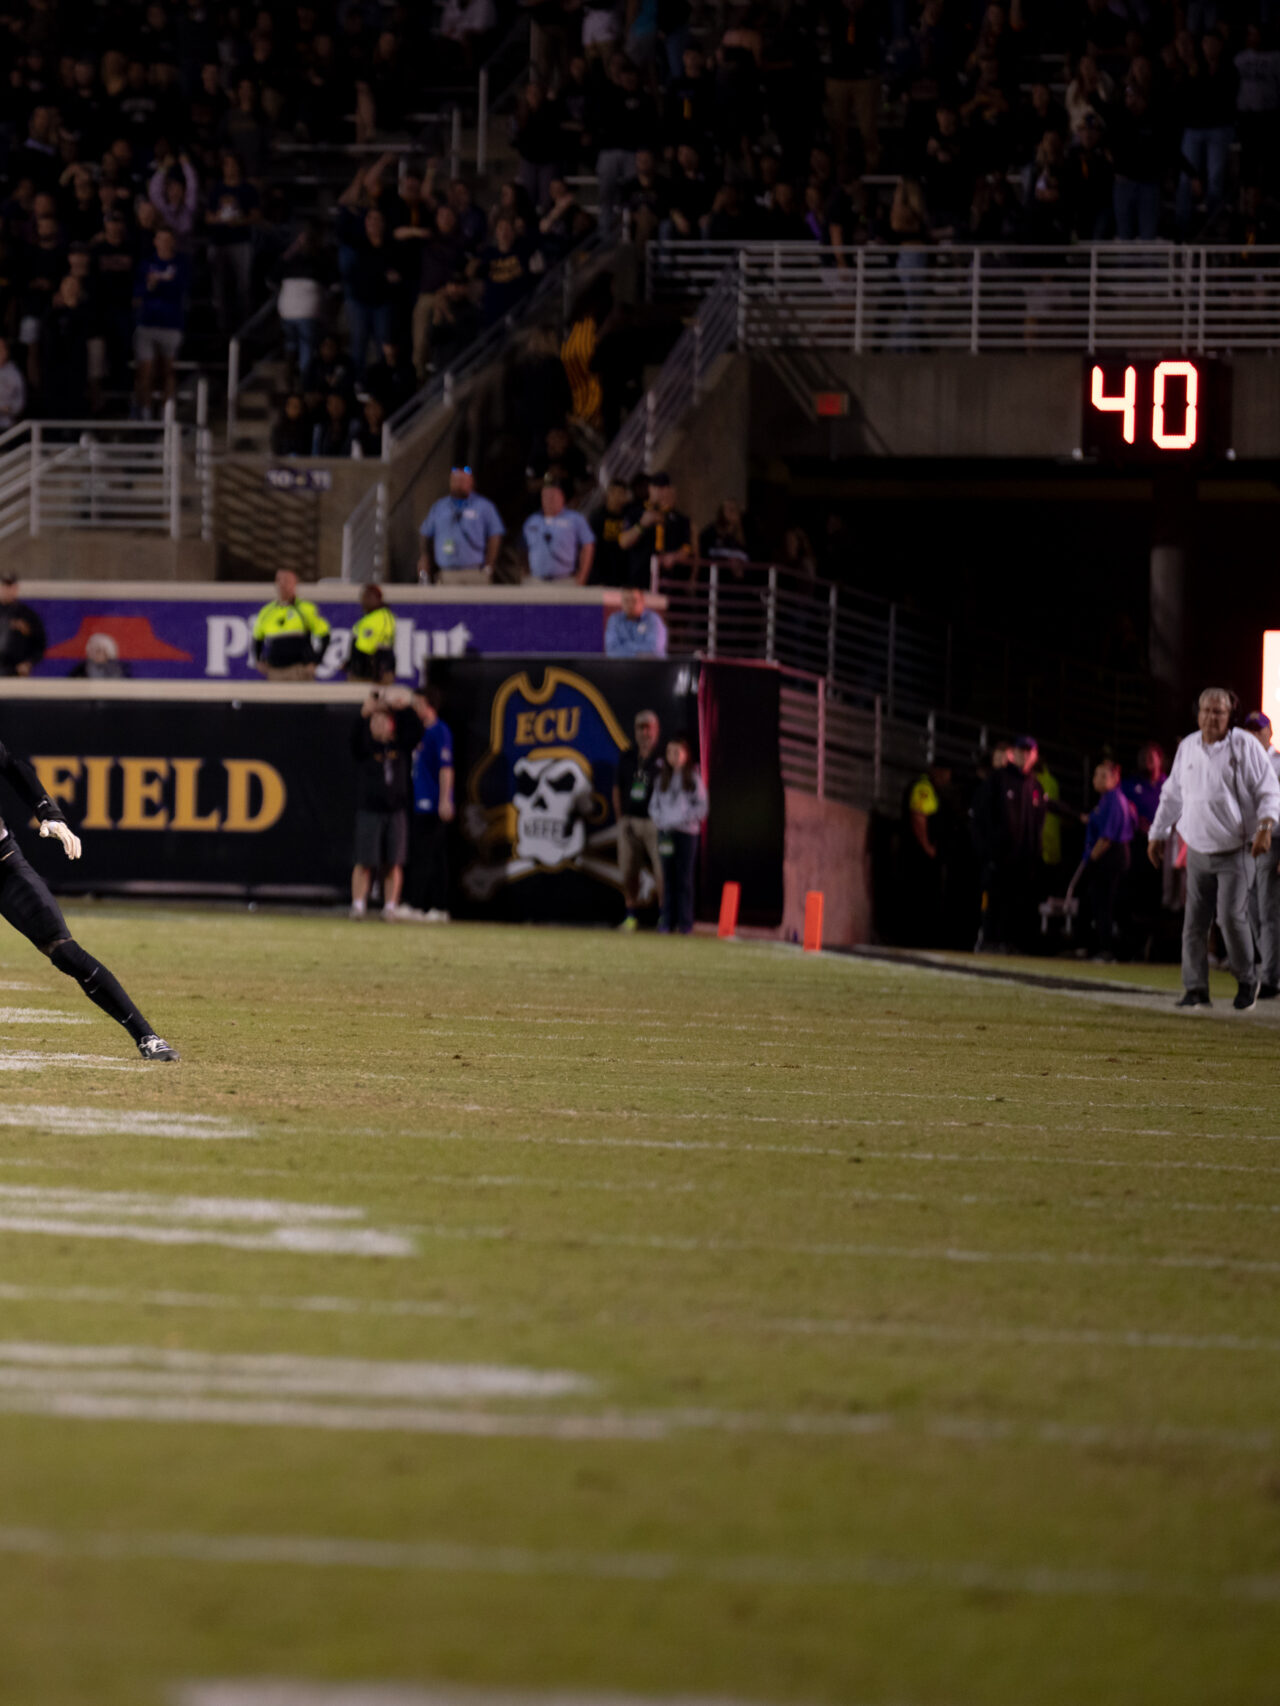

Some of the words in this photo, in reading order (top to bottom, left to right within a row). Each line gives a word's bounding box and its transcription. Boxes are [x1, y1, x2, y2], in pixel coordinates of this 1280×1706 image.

[1091, 361, 1198, 450] 40
[514, 706, 581, 746] ECU
[28, 755, 287, 833] FIELD
